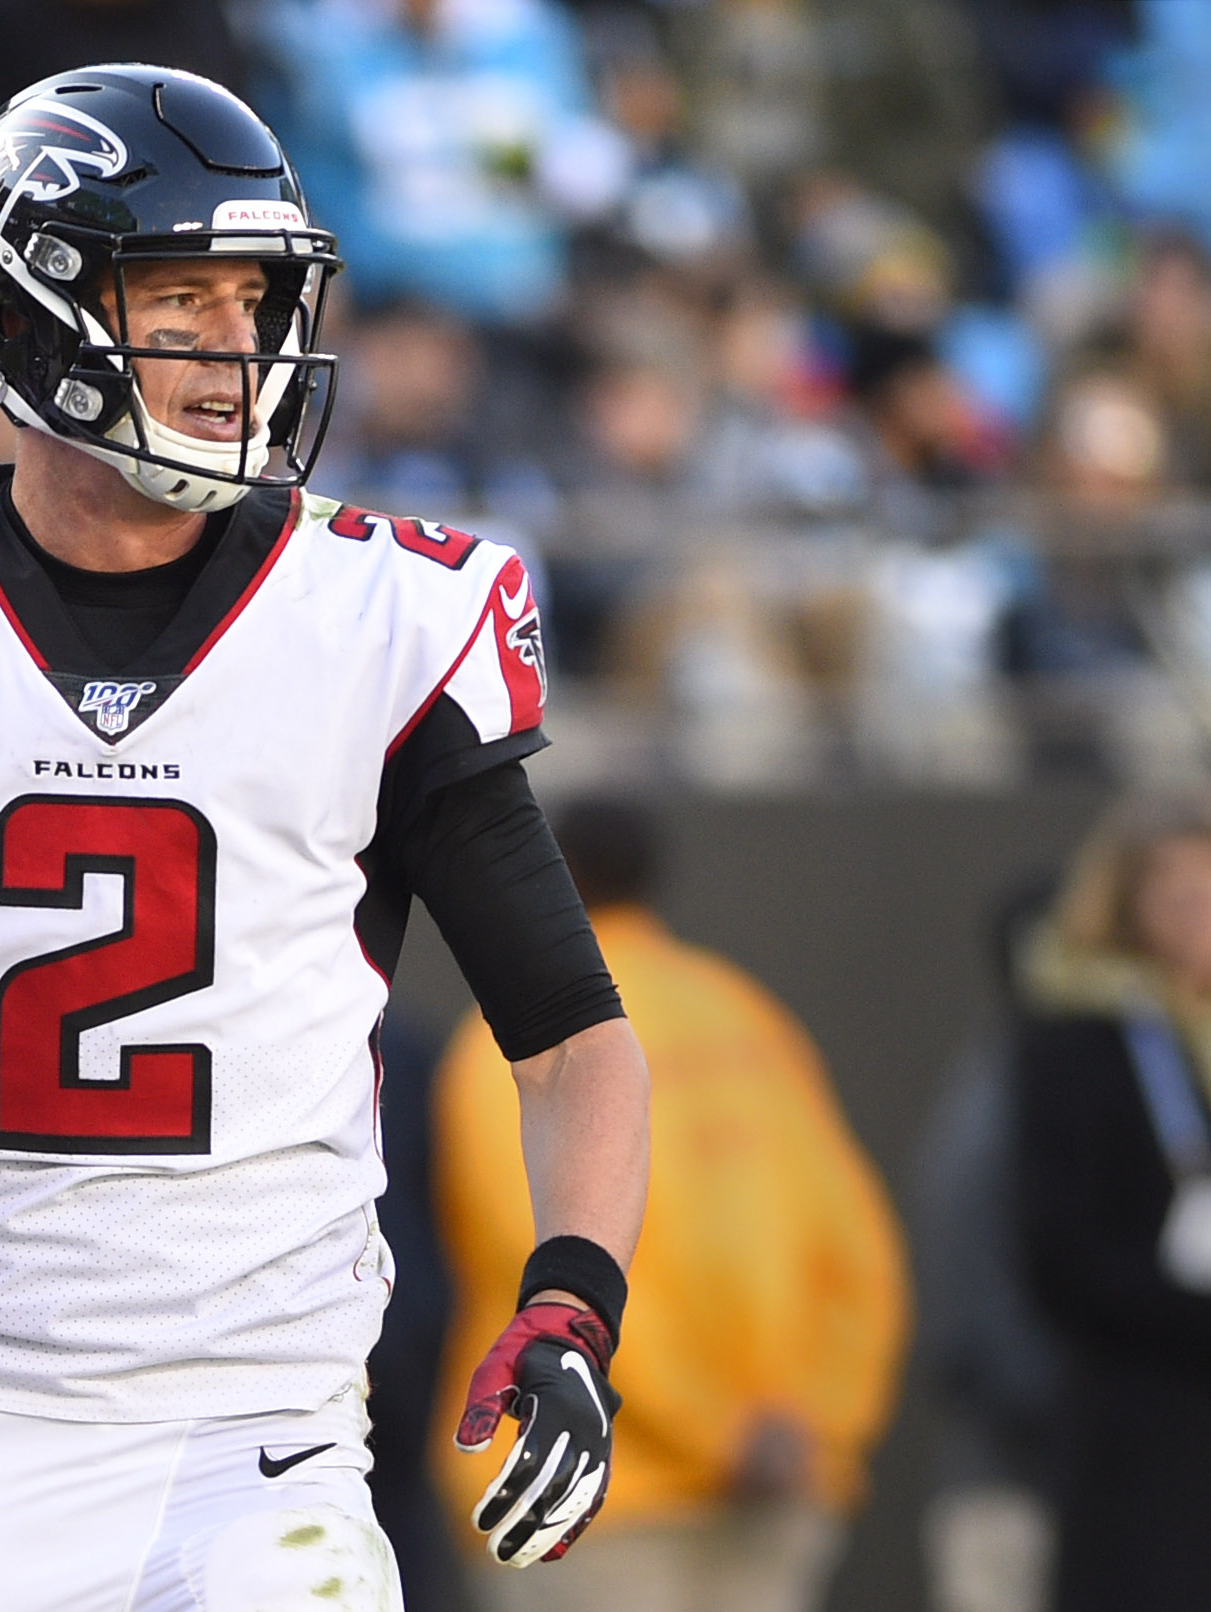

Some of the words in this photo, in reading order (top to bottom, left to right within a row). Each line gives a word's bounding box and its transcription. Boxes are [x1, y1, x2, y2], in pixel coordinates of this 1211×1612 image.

[228, 210, 298, 222] FALCONS
[327, 503, 481, 571] 2
[102, 713, 123, 727] NFL
[33, 760, 180, 779] FALCONS
